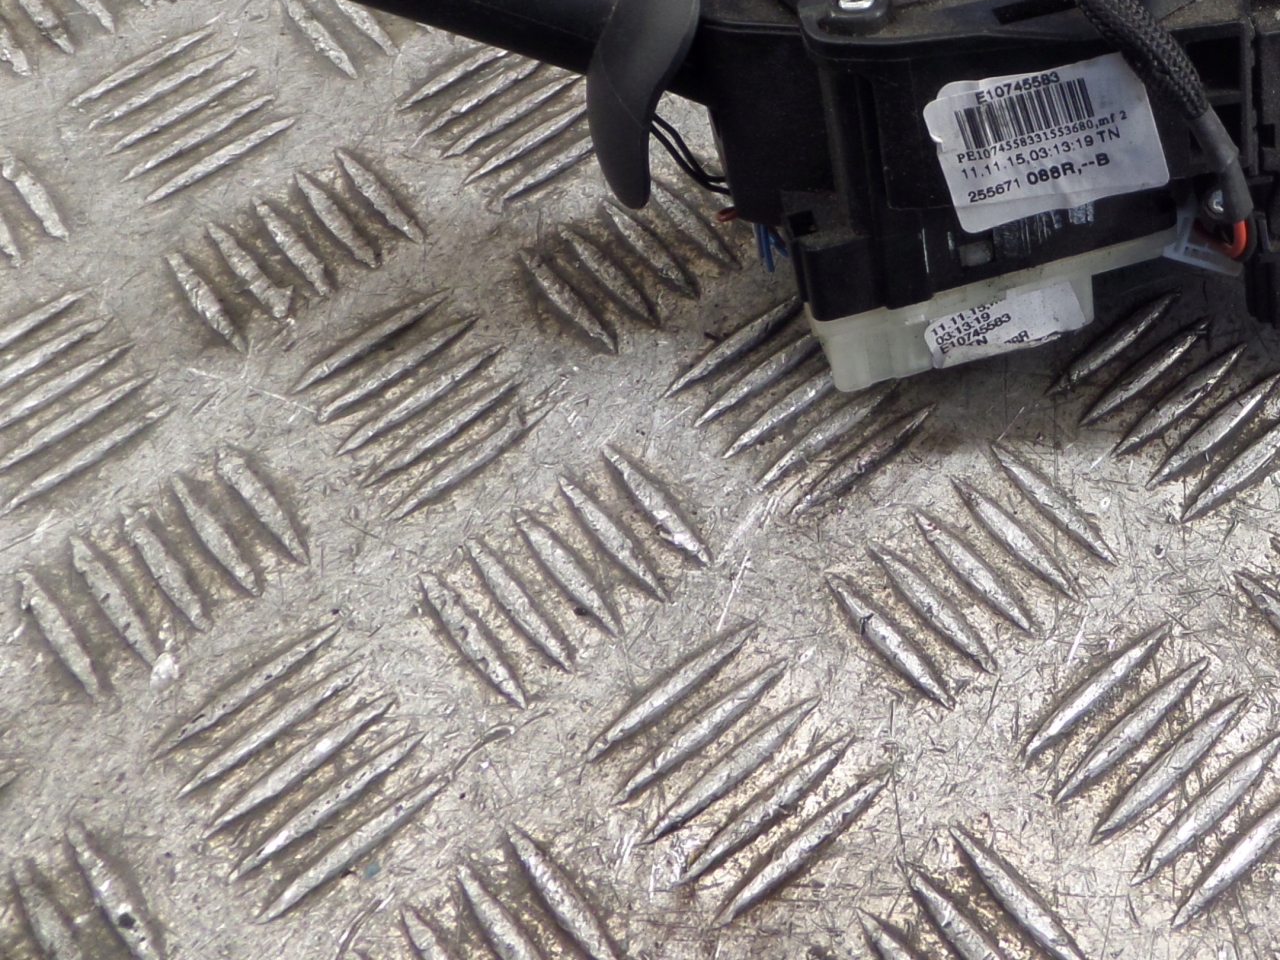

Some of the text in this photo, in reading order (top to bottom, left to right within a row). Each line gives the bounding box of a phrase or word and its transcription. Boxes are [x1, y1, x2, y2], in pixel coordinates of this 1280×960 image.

[975, 71, 1060, 105] E10745583
[1096, 126, 1121, 146] TN
[967, 178, 1022, 203] 255671
[935, 312, 991, 346] 03:13:19
[939, 313, 1012, 355] E10745583
